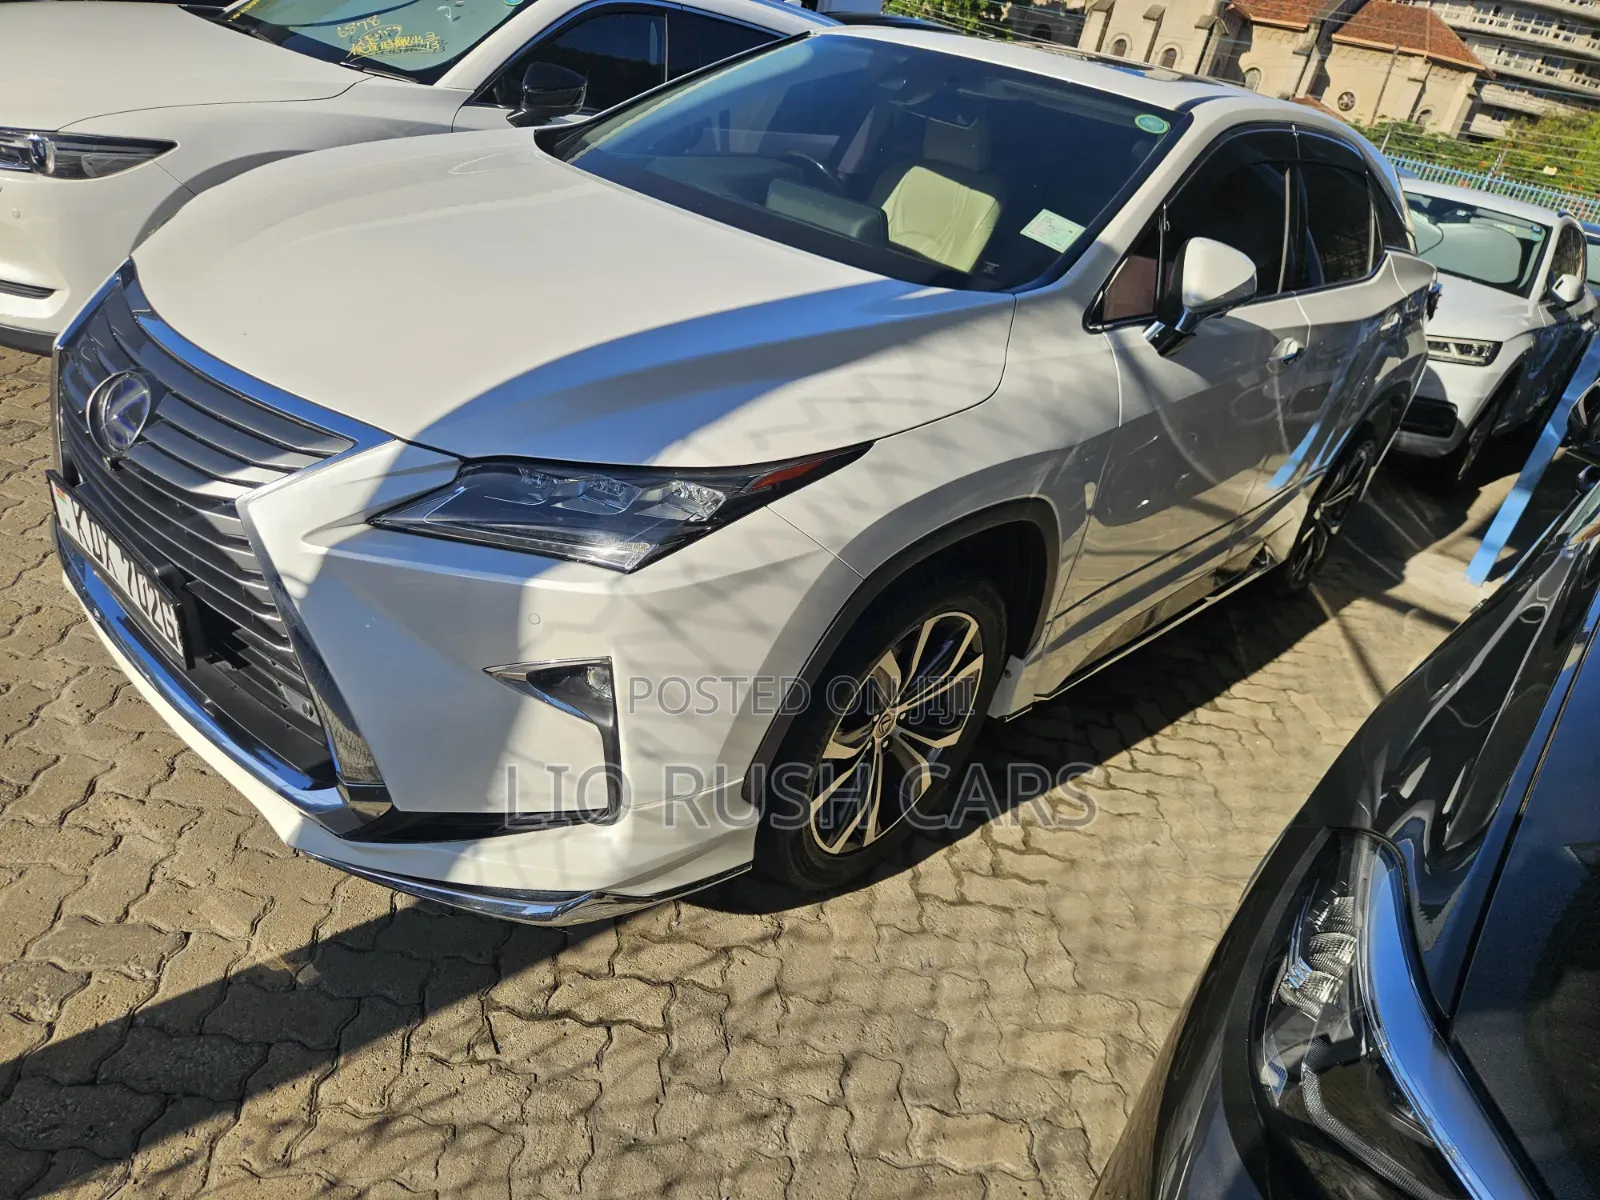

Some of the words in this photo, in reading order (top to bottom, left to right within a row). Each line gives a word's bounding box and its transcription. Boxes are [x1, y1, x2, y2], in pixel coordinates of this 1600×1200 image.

[337, 15, 380, 37] 6878
[70, 495, 119, 581] KDX
[119, 547, 181, 652] 702G
